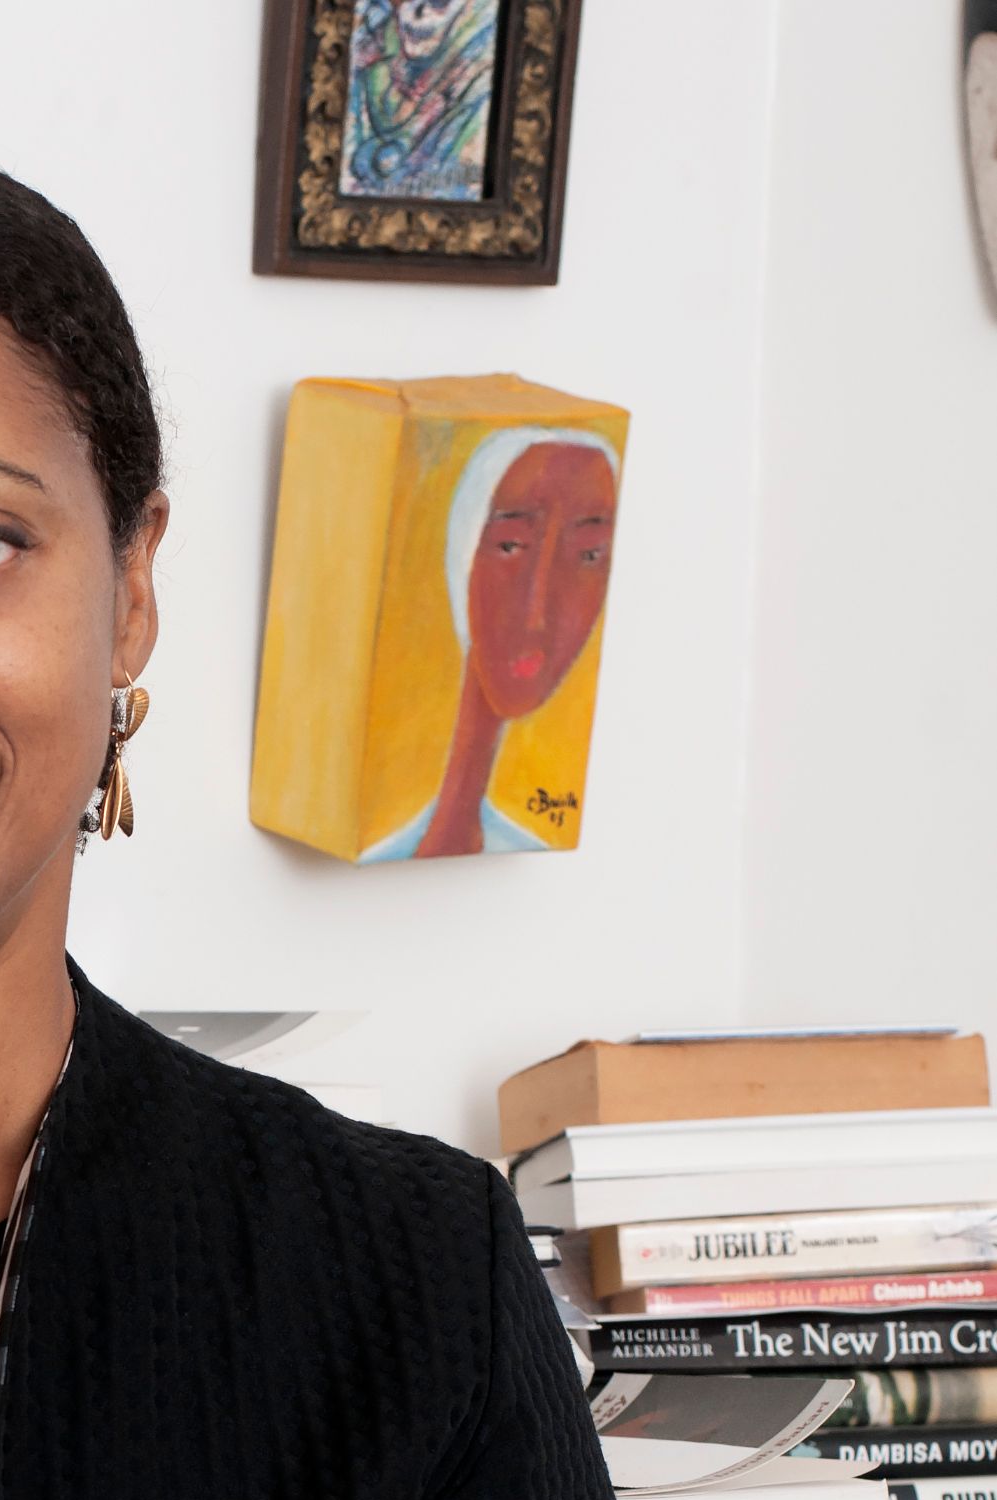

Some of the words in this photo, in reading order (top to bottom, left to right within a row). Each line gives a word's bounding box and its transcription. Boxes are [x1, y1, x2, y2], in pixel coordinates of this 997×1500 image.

[689, 1229, 797, 1262] JUBILEE
[720, 1290, 775, 1307] THINGS
[780, 1288, 813, 1305] FALL
[817, 1285, 868, 1303] APART
[873, 1283, 926, 1300] Chinua
[928, 1279, 984, 1298] Achebe
[611, 1327, 701, 1343] MICHELLE
[726, 1320, 794, 1357] The
[800, 1322, 878, 1356] New
[883, 1320, 943, 1362] Jim
[612, 1343, 714, 1358] ALEXANDER
[839, 1441, 943, 1465] DAMBISA
